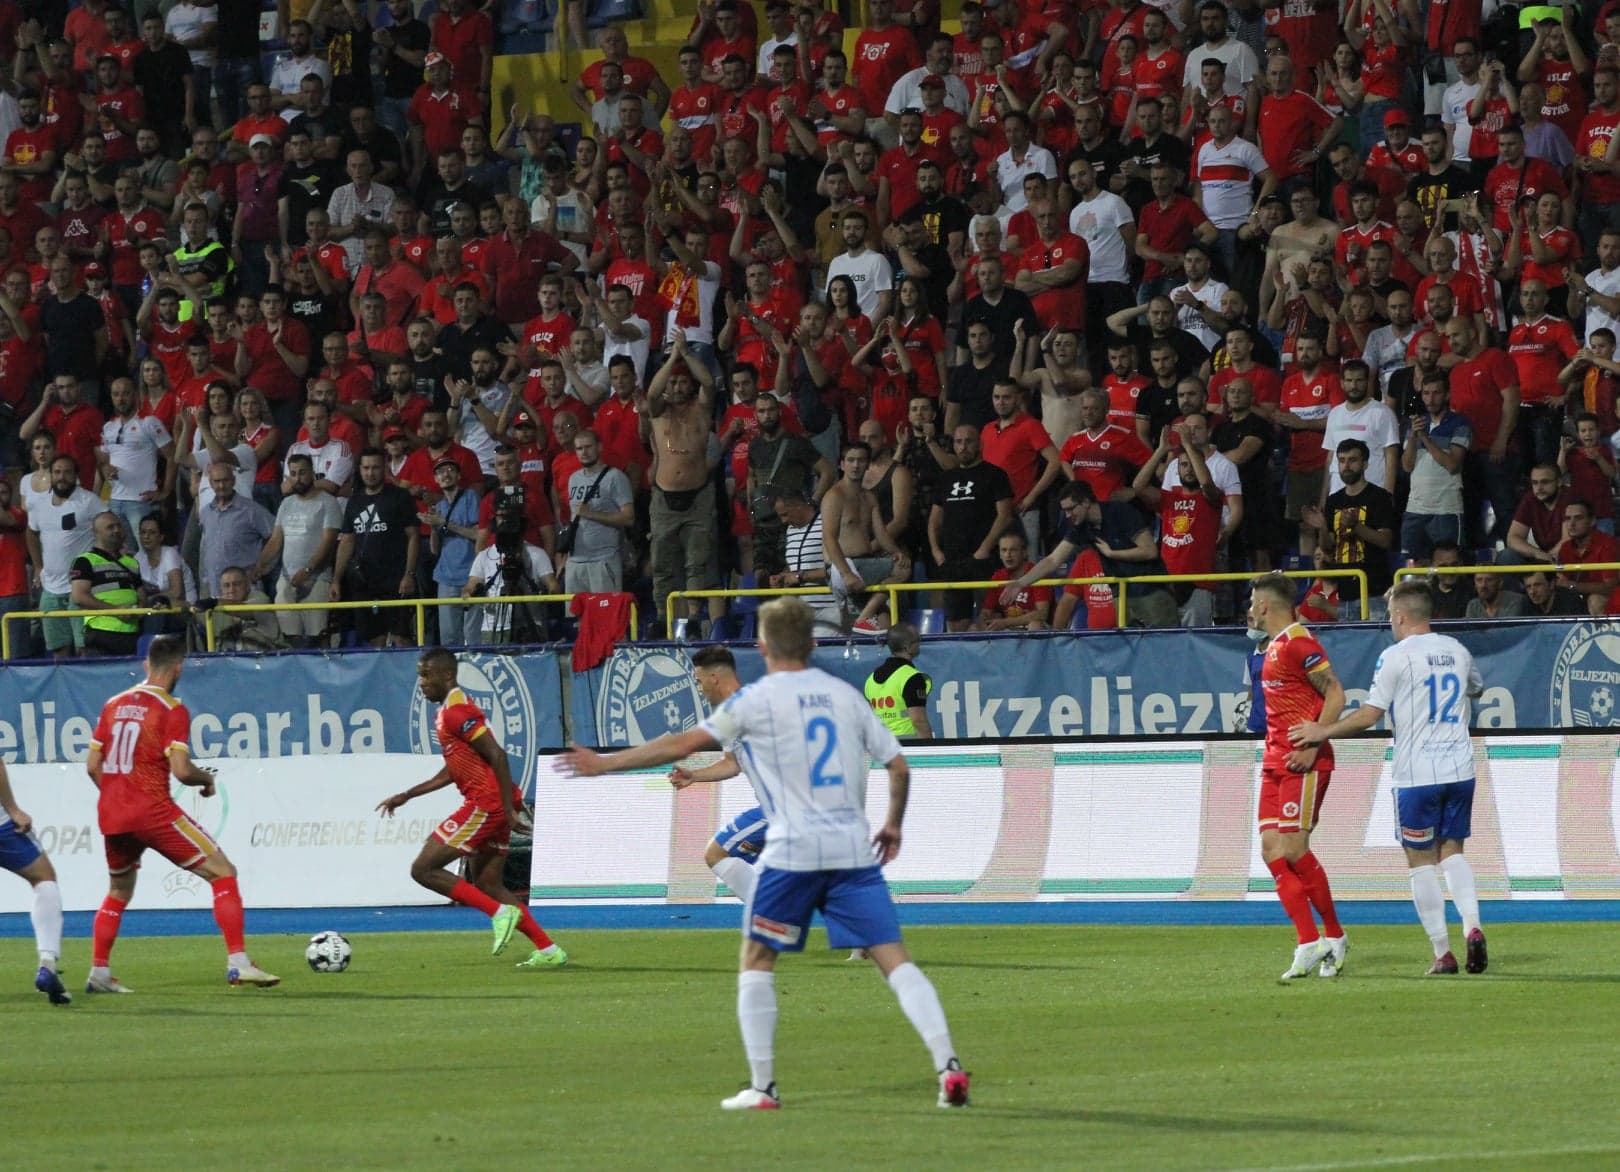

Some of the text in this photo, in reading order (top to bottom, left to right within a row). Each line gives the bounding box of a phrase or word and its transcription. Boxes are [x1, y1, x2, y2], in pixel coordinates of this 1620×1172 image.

[1427, 654, 1456, 667] WILSON
[1424, 673, 1460, 724] 12
[102, 720, 141, 774] 10
[806, 715, 844, 788] 2
[38, 825, 93, 854] OPA
[250, 818, 438, 848] CONFERENCE LEAGU
